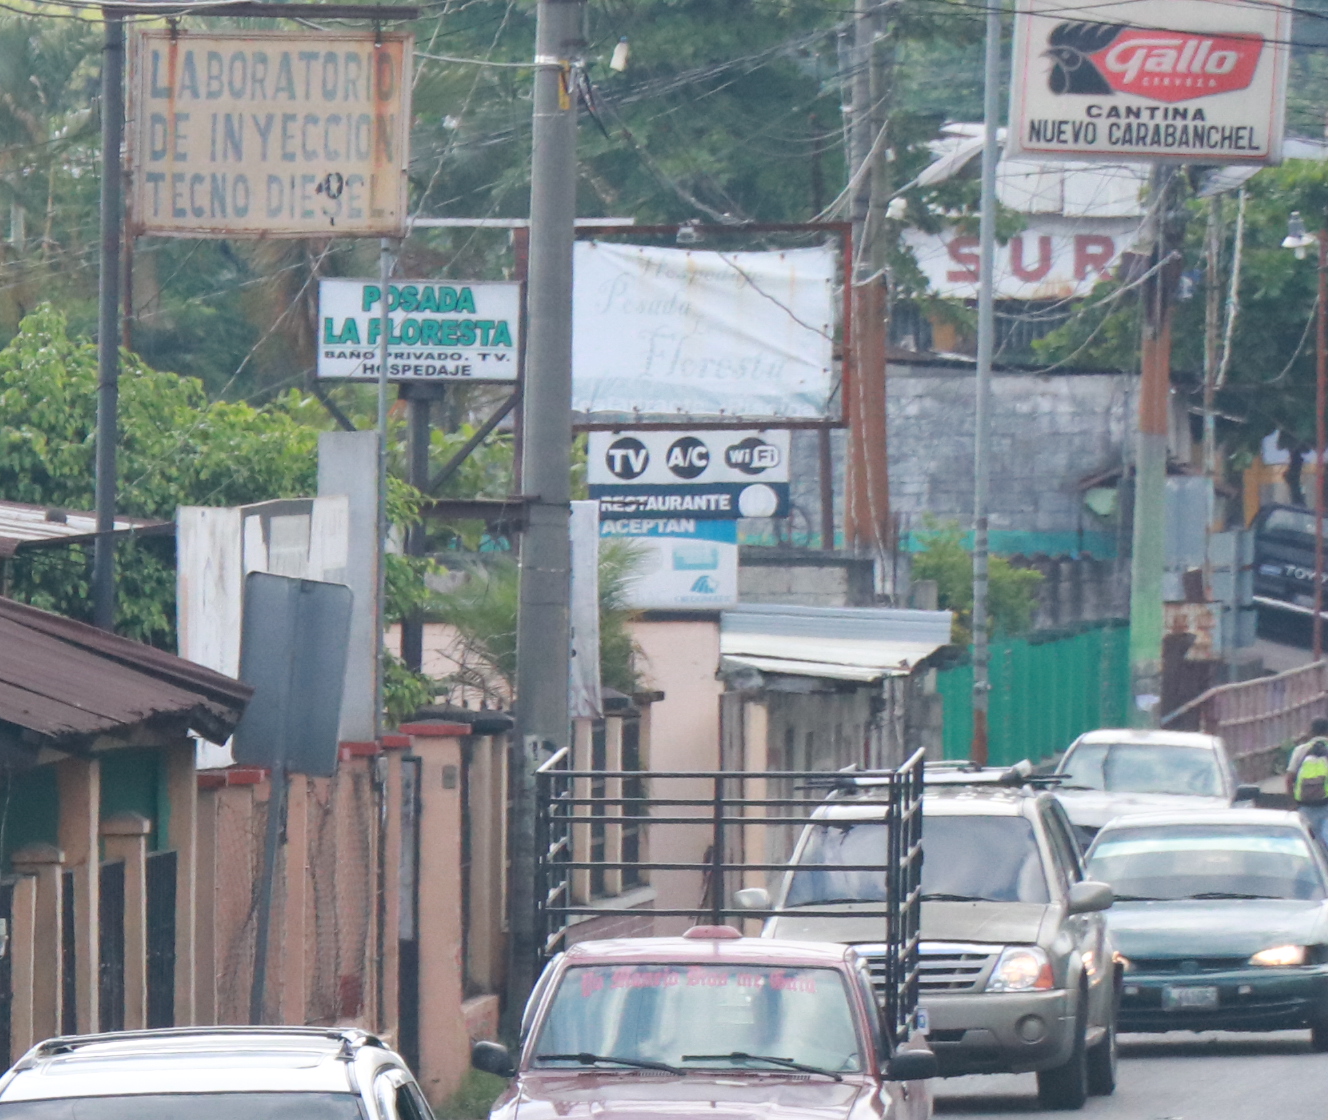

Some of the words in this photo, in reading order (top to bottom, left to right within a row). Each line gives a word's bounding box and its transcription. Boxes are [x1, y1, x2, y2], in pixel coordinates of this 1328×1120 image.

[149, 49, 395, 100] LABORATORIO
[1105, 38, 1239, 85] Gallo
[1086, 104, 1206, 122] CANTINA
[149, 112, 190, 162] DE
[210, 112, 395, 163] INYECCION
[1029, 119, 1098, 145] NUEVO
[1108, 122, 1261, 150] CARABANCHEL
[146, 171, 251, 219] TECNO
[947, 234, 1116, 283] SUR
[362, 285, 477, 314] POSADA
[323, 317, 360, 345] LA
[367, 317, 513, 348] FLORESTA
[324, 349, 375, 360] BAÑO
[609, 448, 647, 474] TV
[667, 446, 708, 468] A/C
[600, 494, 732, 512] RESTAURANTE
[601, 519, 697, 534] ACEPTAN
